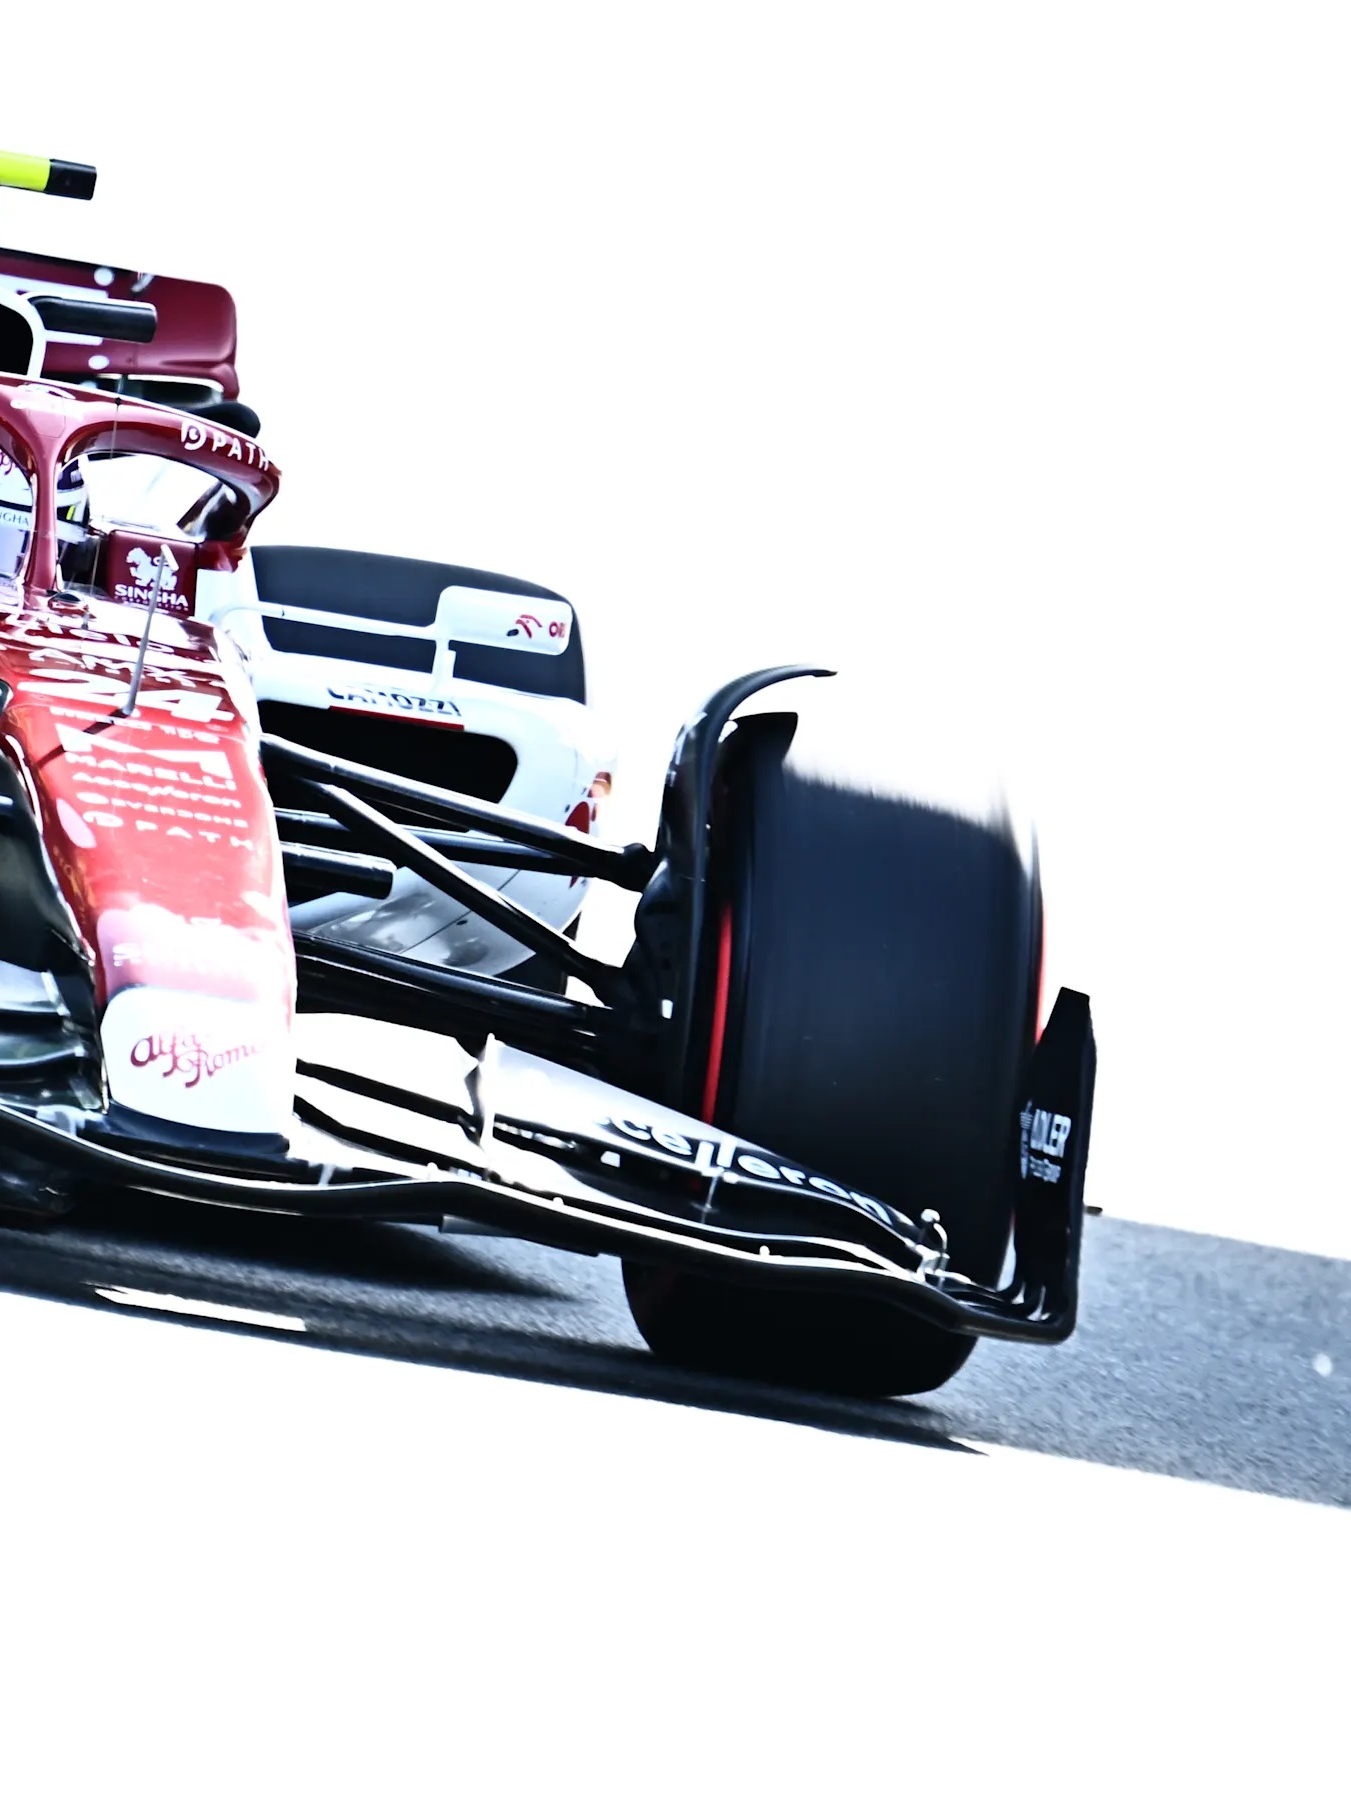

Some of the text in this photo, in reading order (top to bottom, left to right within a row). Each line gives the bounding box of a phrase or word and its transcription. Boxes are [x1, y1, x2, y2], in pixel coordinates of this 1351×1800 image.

[212, 434, 270, 472] PATH
[114, 583, 189, 608] SINGHA
[64, 751, 237, 791] MARELLI
[135, 820, 255, 850] PATH
